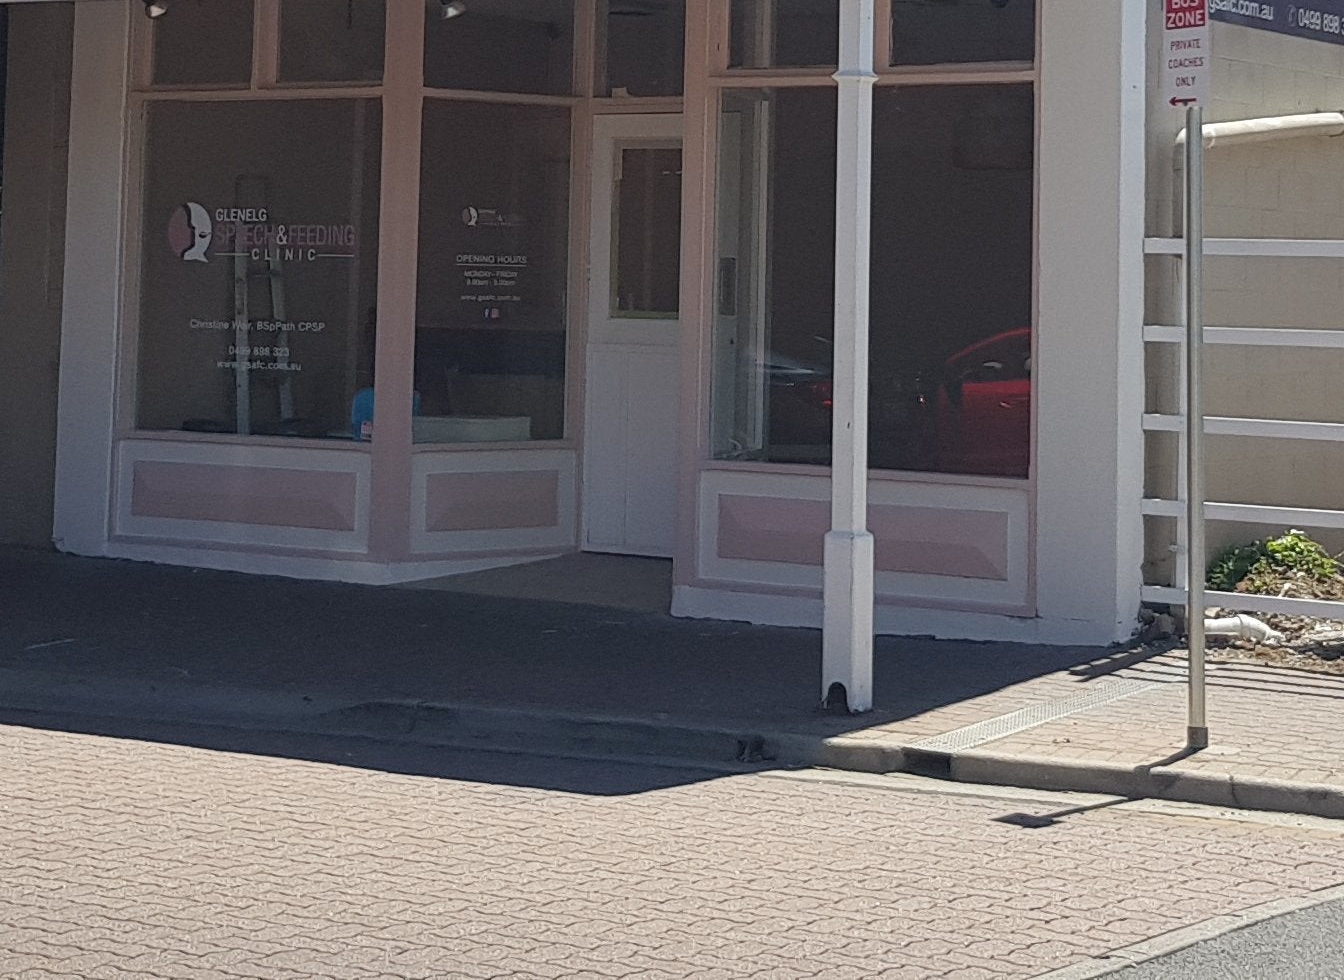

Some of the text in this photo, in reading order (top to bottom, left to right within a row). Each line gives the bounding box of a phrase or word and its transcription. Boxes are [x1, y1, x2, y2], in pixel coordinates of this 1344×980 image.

[1167, 10, 1204, 28] ZONE
[1298, 8, 1321, 30] 0499
[1322, 13, 1340, 34] 898
[1170, 38, 1201, 51] PRIVATE
[1168, 57, 1204, 69] COACHES
[1176, 76, 1196, 87] ONLY
[215, 208, 267, 221] GLENELG
[251, 248, 316, 261] CLINIC
[456, 254, 527, 264] OPENING HOURS
[297, 322, 326, 332] CPSP
